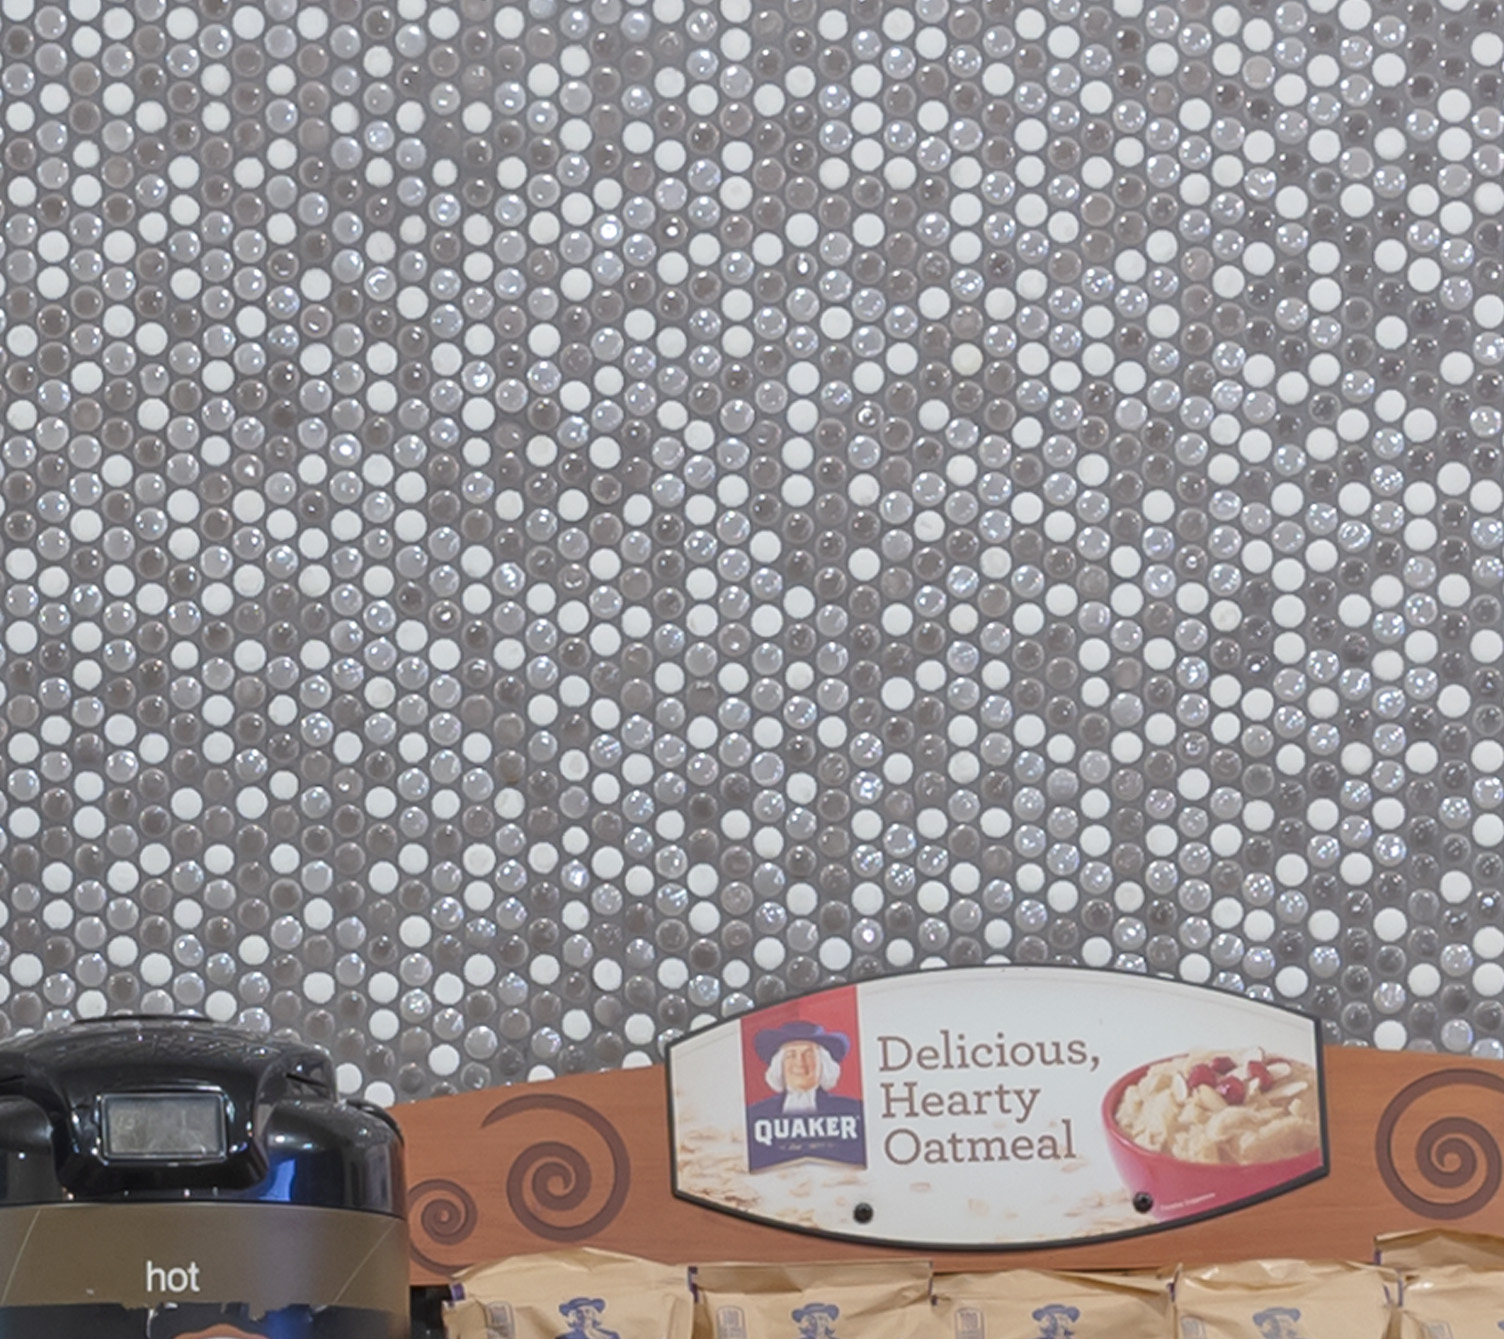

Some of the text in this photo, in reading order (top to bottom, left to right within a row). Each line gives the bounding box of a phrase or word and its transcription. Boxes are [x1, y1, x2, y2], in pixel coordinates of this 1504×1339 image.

[877, 1029, 1100, 1073] Delicious,
[880, 1081, 1041, 1124] Hearty
[754, 1116, 860, 1146] QUAKER
[884, 1119, 1076, 1166] Oatmeal
[146, 1260, 200, 1292] hot
